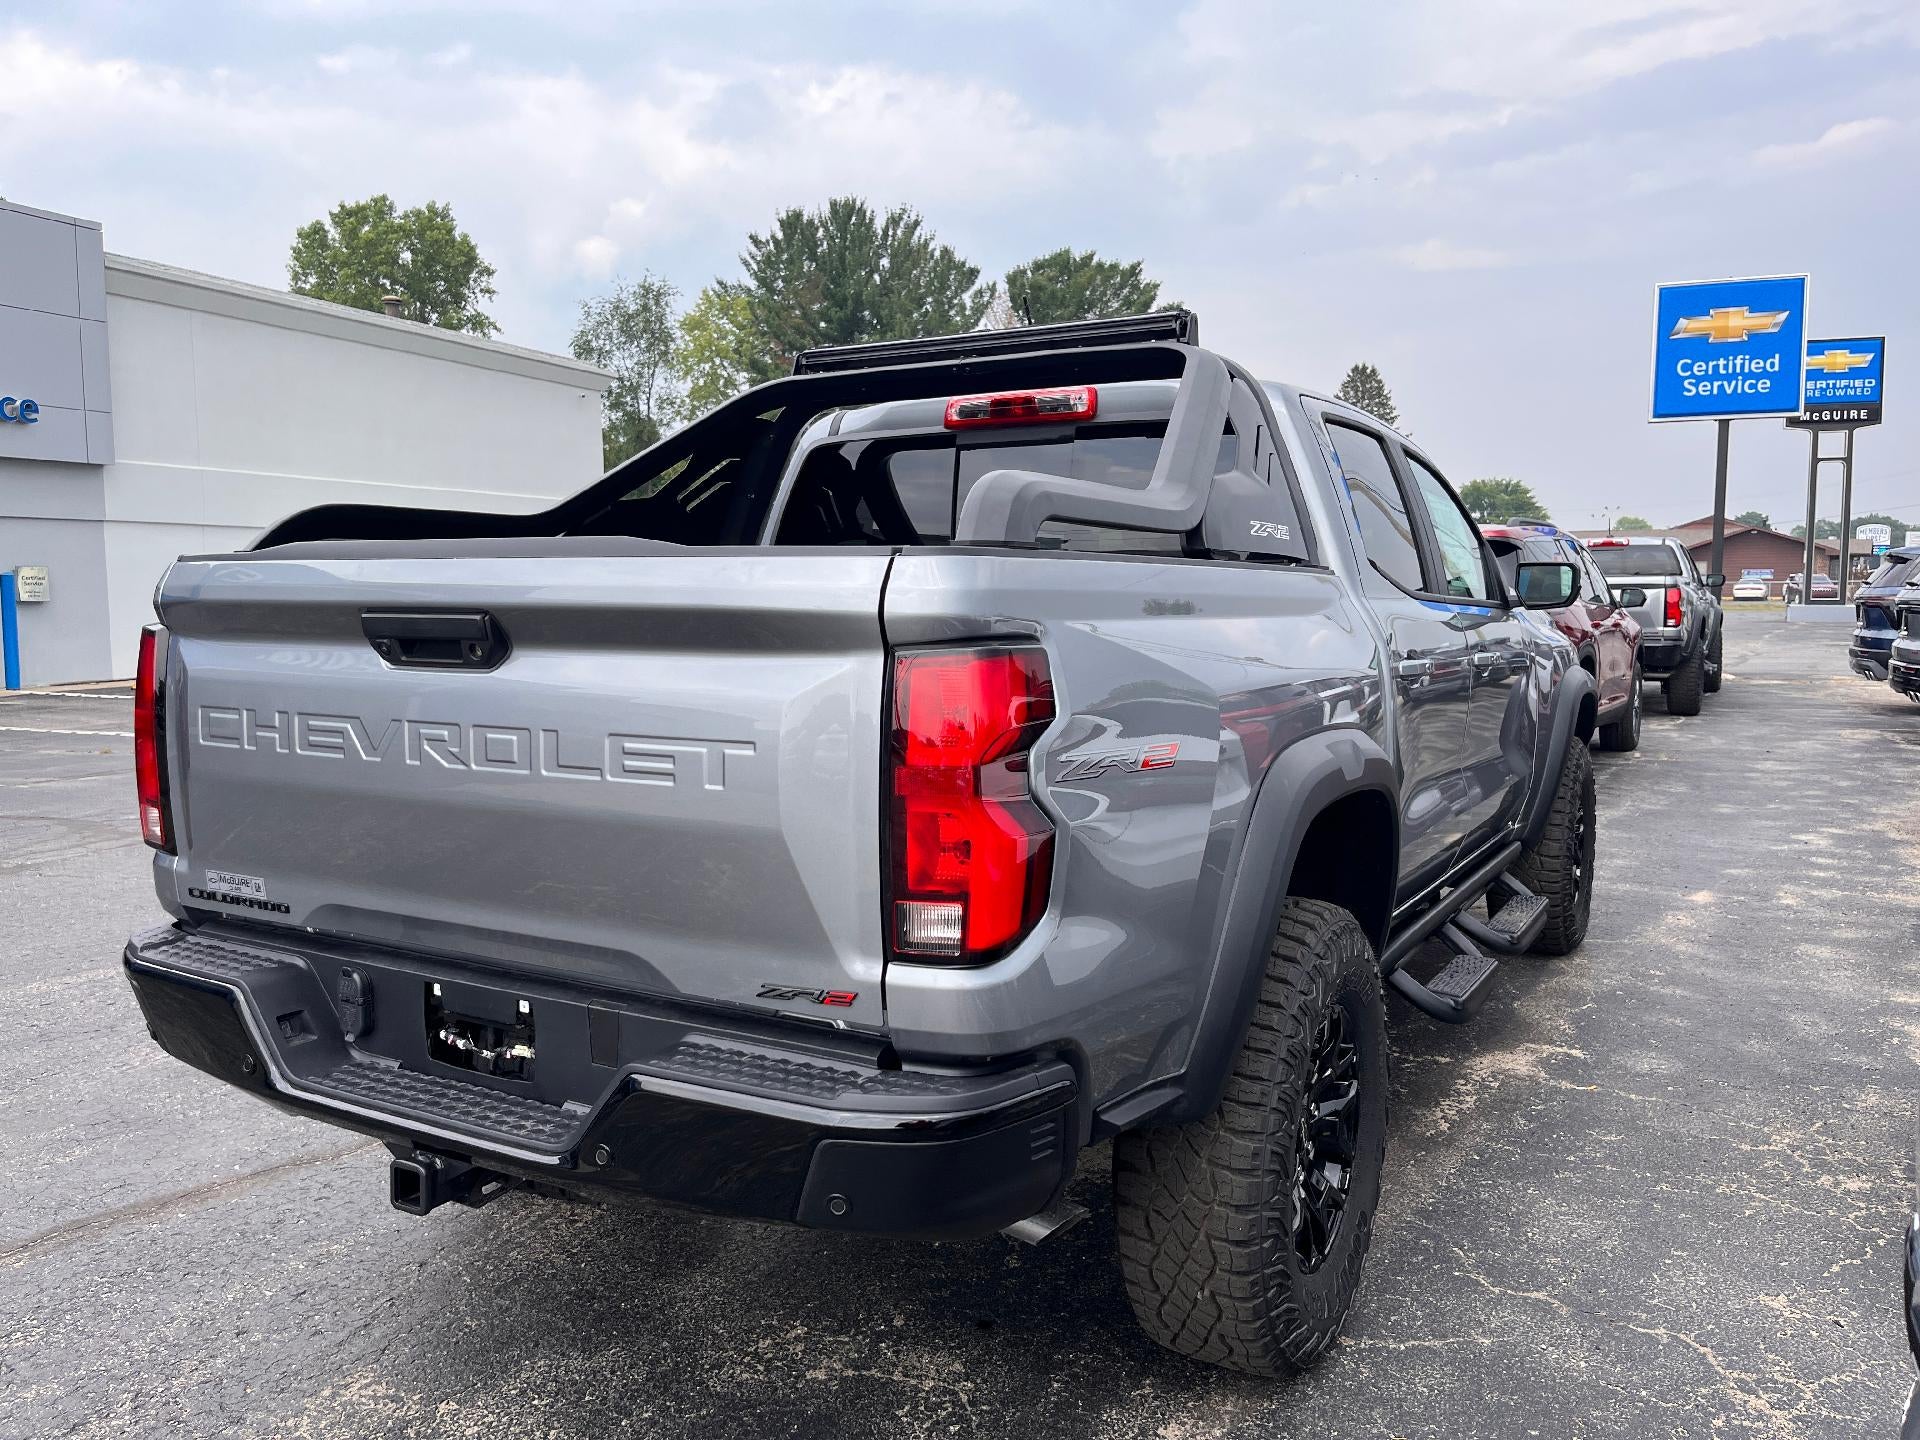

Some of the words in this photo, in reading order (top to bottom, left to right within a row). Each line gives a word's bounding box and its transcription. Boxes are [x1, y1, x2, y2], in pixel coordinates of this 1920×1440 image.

[1676, 353, 1780, 377] Certified
[1682, 375, 1771, 397] Service
[1806, 379, 1876, 390] ERTIFIED
[1806, 387, 1871, 398] RE-OWNED
[1249, 520, 1290, 540] ZR2
[197, 704, 757, 792] CHEVROLET
[1054, 741, 1180, 783] ZR2
[188, 886, 290, 914] COLORADO
[755, 983, 859, 1007] ZR2
